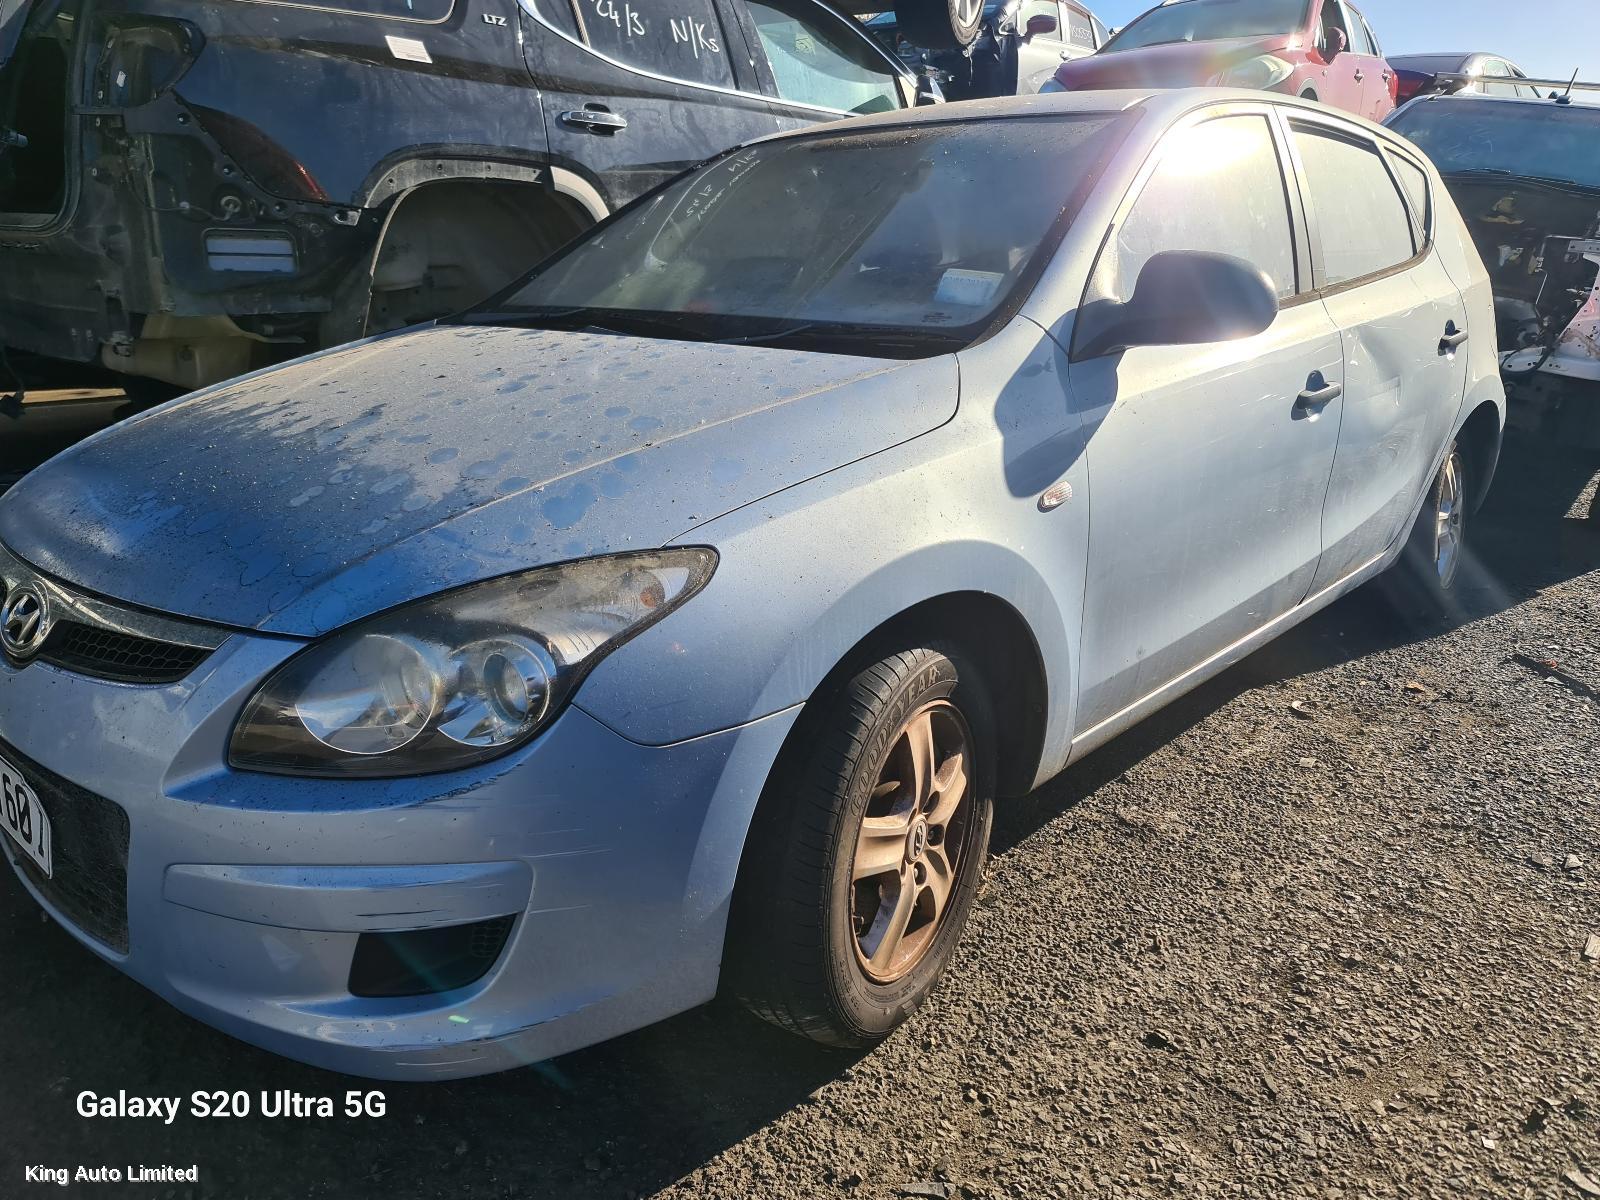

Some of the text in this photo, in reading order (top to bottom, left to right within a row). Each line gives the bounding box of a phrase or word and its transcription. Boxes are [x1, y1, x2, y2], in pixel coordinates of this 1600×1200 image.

[482, 13, 507, 26] LTZ
[850, 664, 942, 818] GOODYEAR
[0, 772, 45, 858] 601
